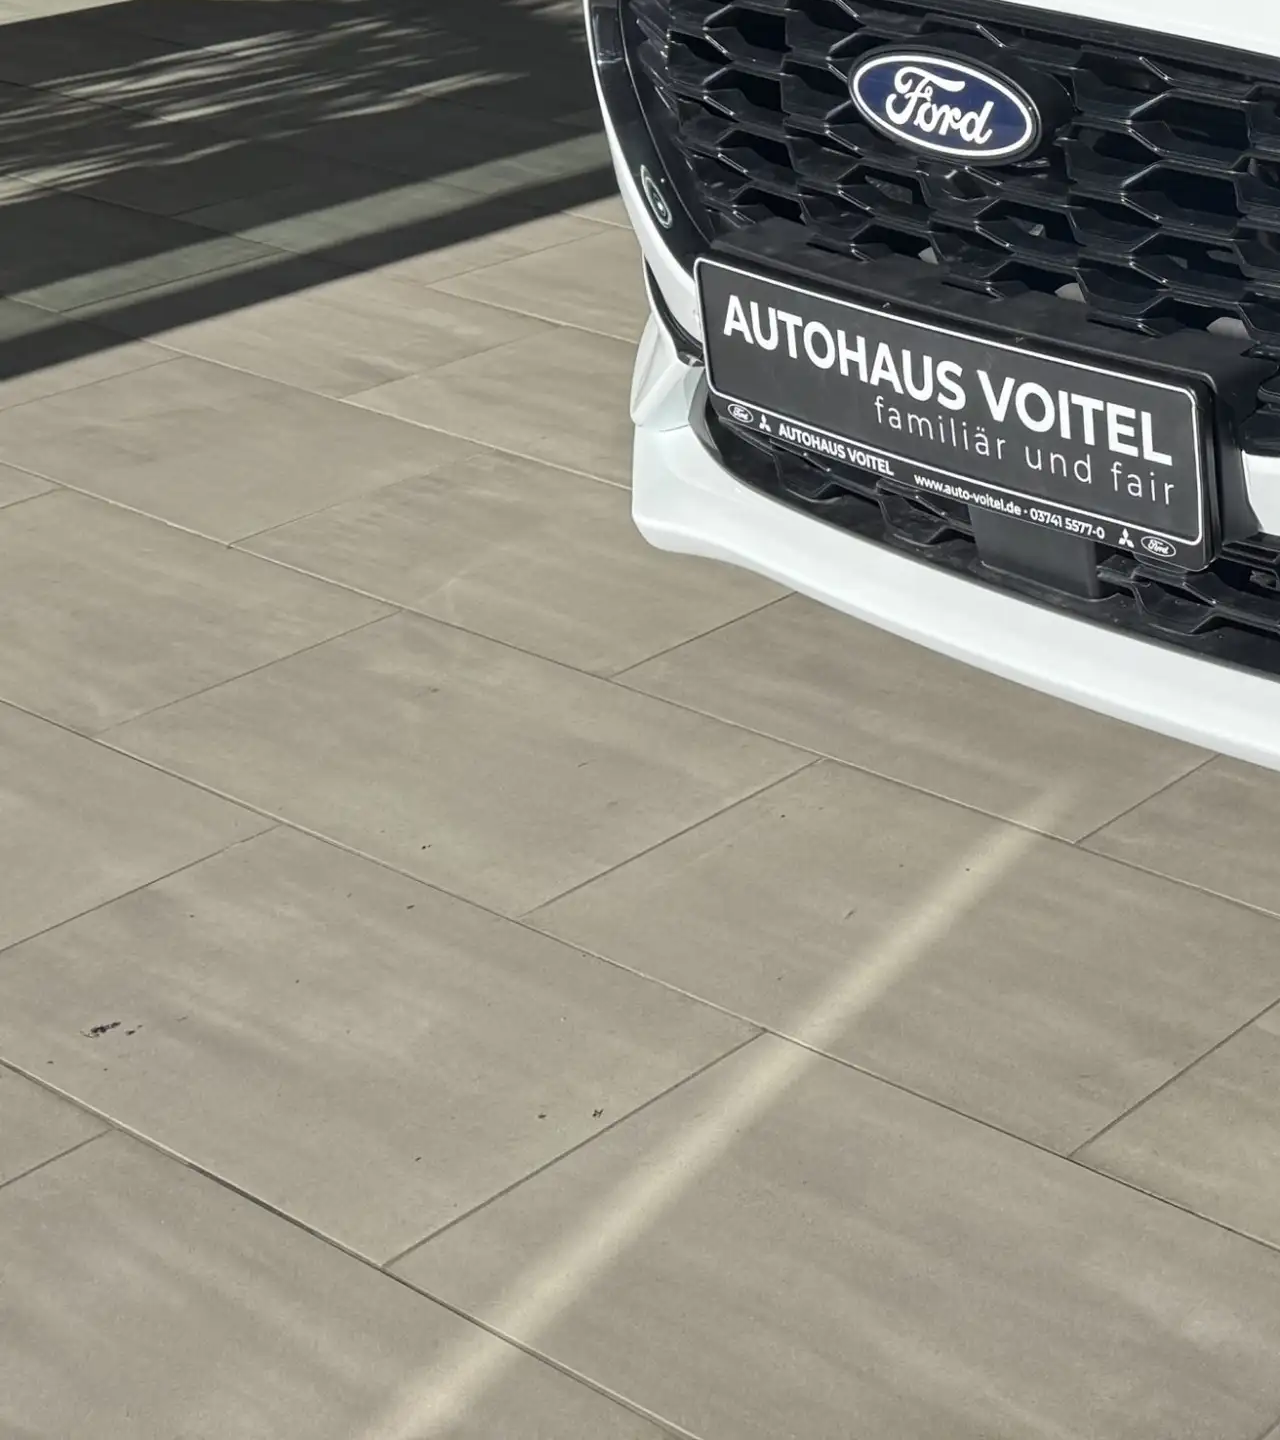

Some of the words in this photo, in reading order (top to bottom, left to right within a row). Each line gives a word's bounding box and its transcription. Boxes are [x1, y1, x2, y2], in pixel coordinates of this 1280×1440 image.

[885, 66, 994, 144] Ford
[723, 294, 966, 410] AUTOHAUS
[977, 370, 1173, 466] VOITEL
[778, 423, 846, 460] AUTOHAUS
[847, 447, 895, 476] VOITEL
[874, 396, 1006, 460] familiär
[1025, 446, 1092, 485] und
[1111, 461, 1175, 506] fair
[914, 474, 1021, 516] www.auto-voitel.de
[1029, 507, 1063, 528] 03741
[1065, 516, 1106, 540] 5577-0
